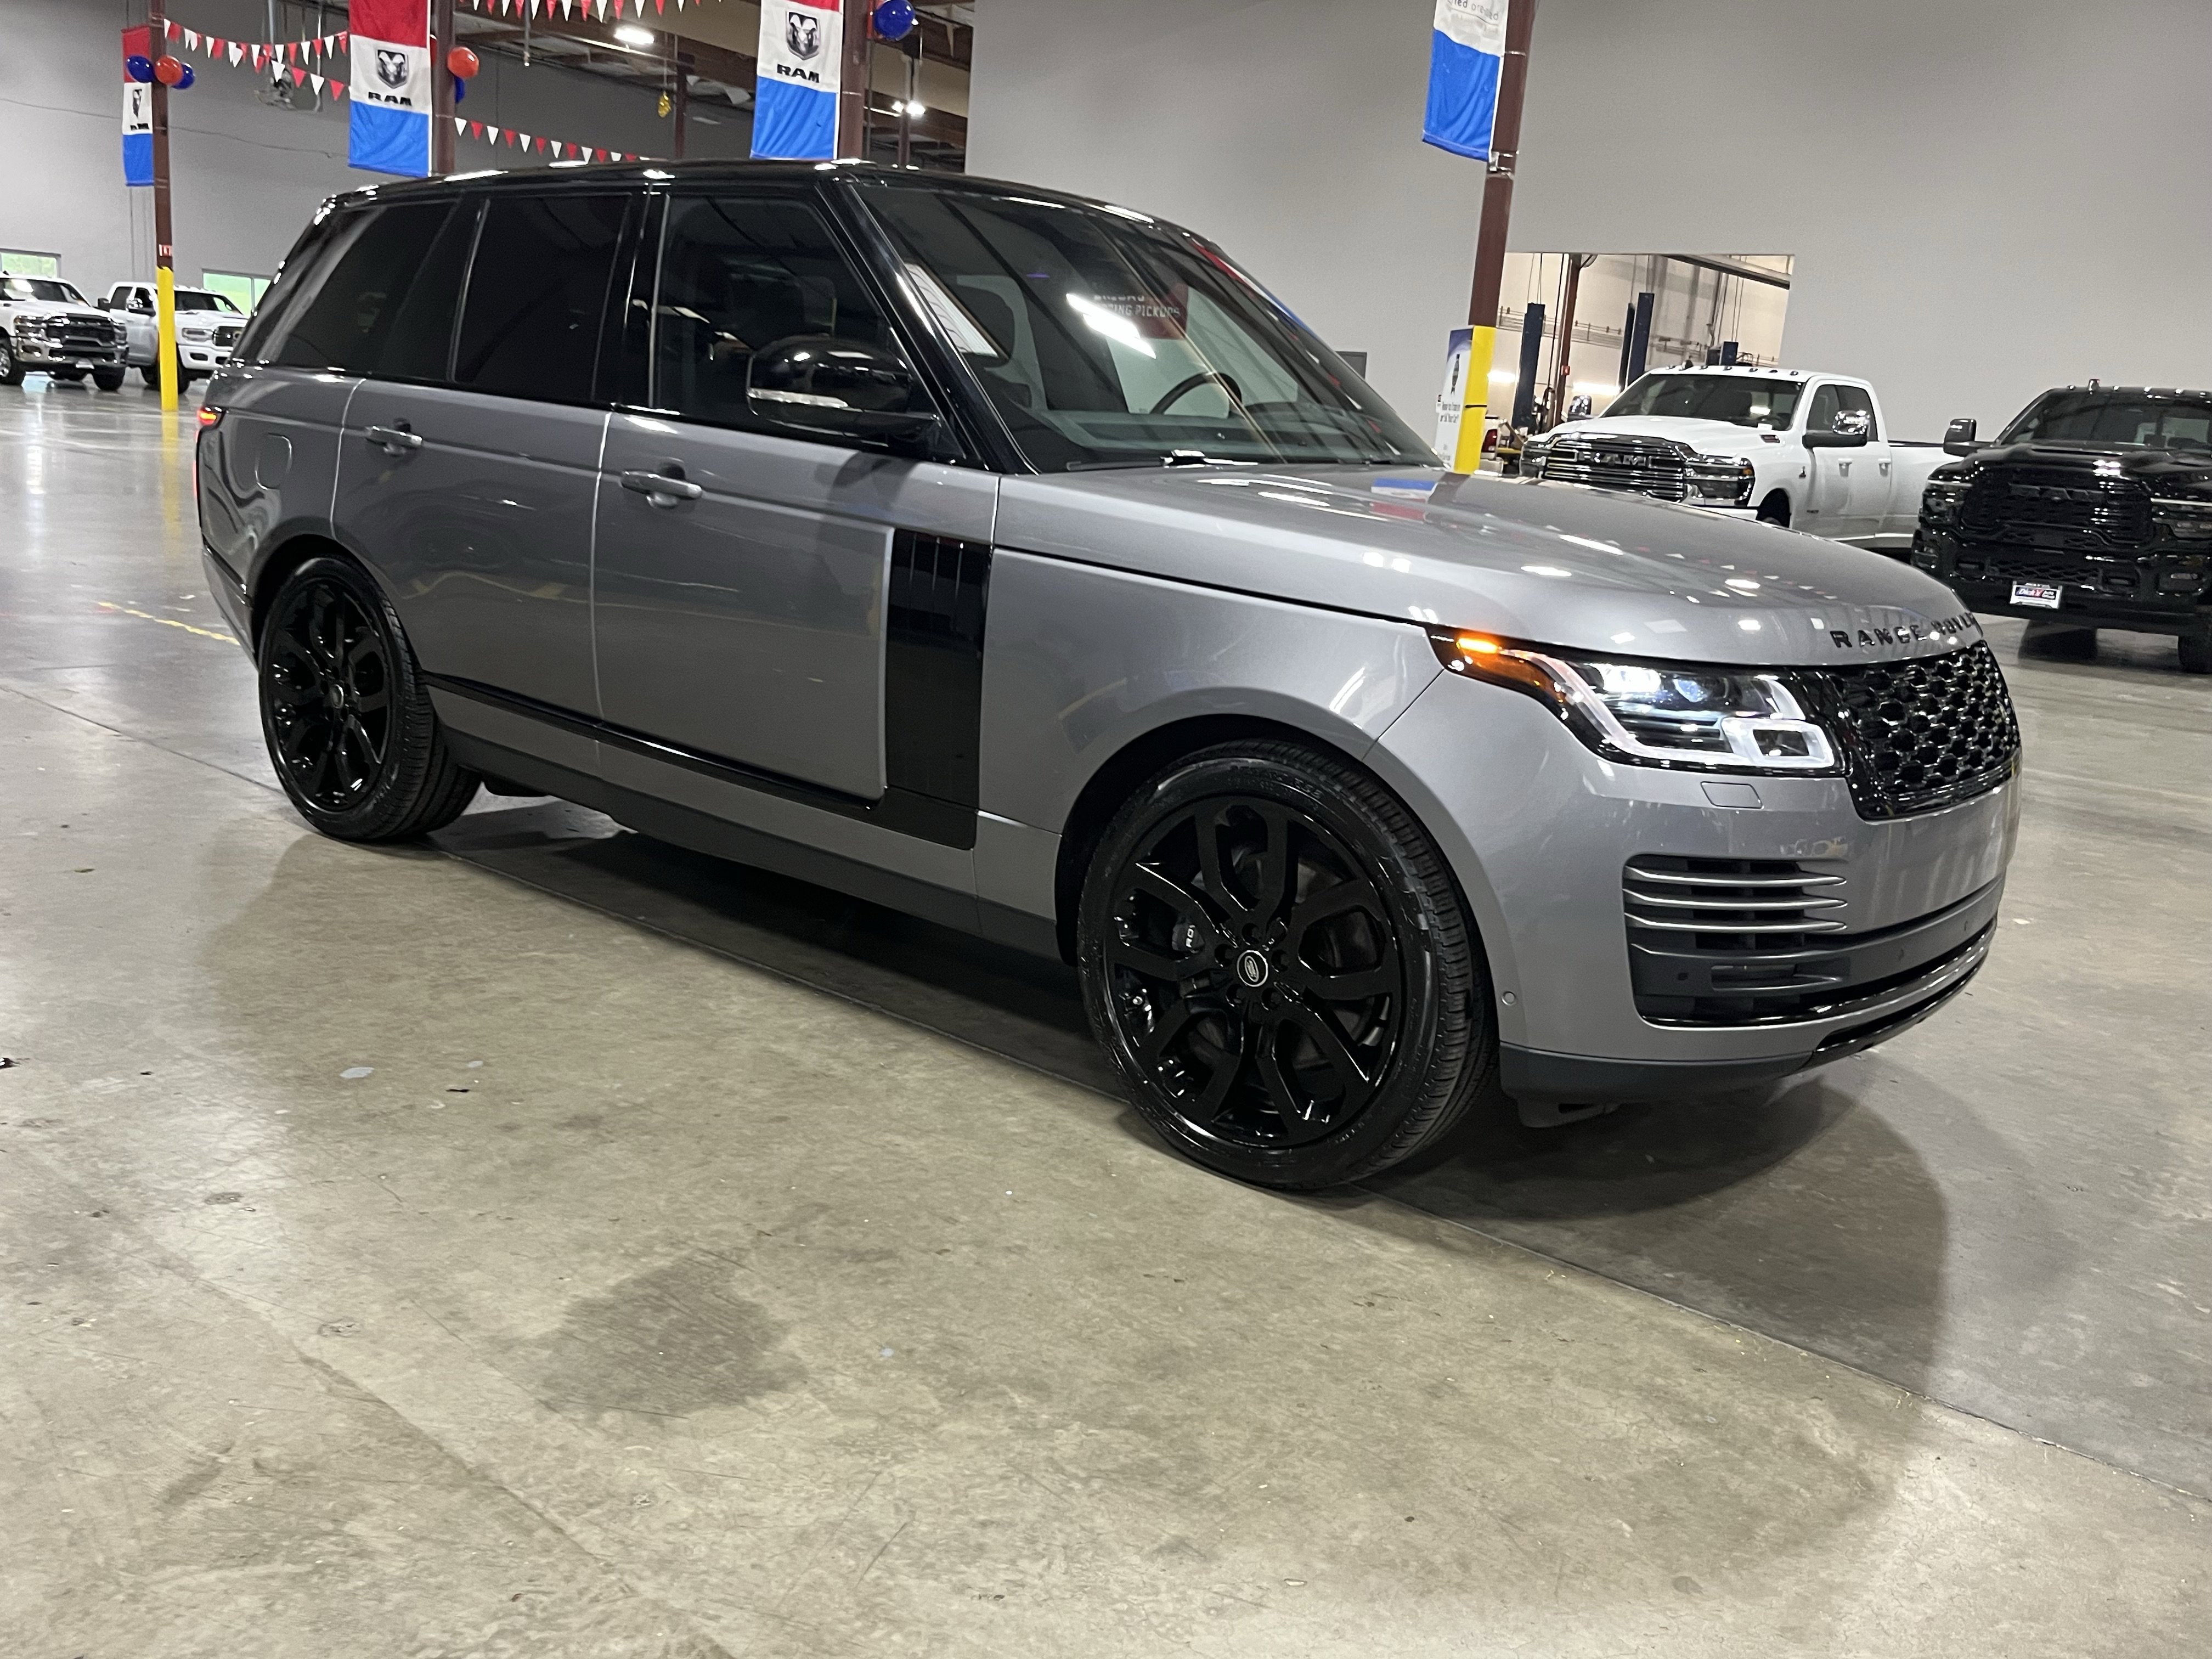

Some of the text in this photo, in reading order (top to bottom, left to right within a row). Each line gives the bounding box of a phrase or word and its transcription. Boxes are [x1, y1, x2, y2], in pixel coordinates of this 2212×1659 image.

[777, 64, 819, 83] RAM
[368, 91, 412, 106] RAM
[1830, 624, 1927, 648] RANGE
